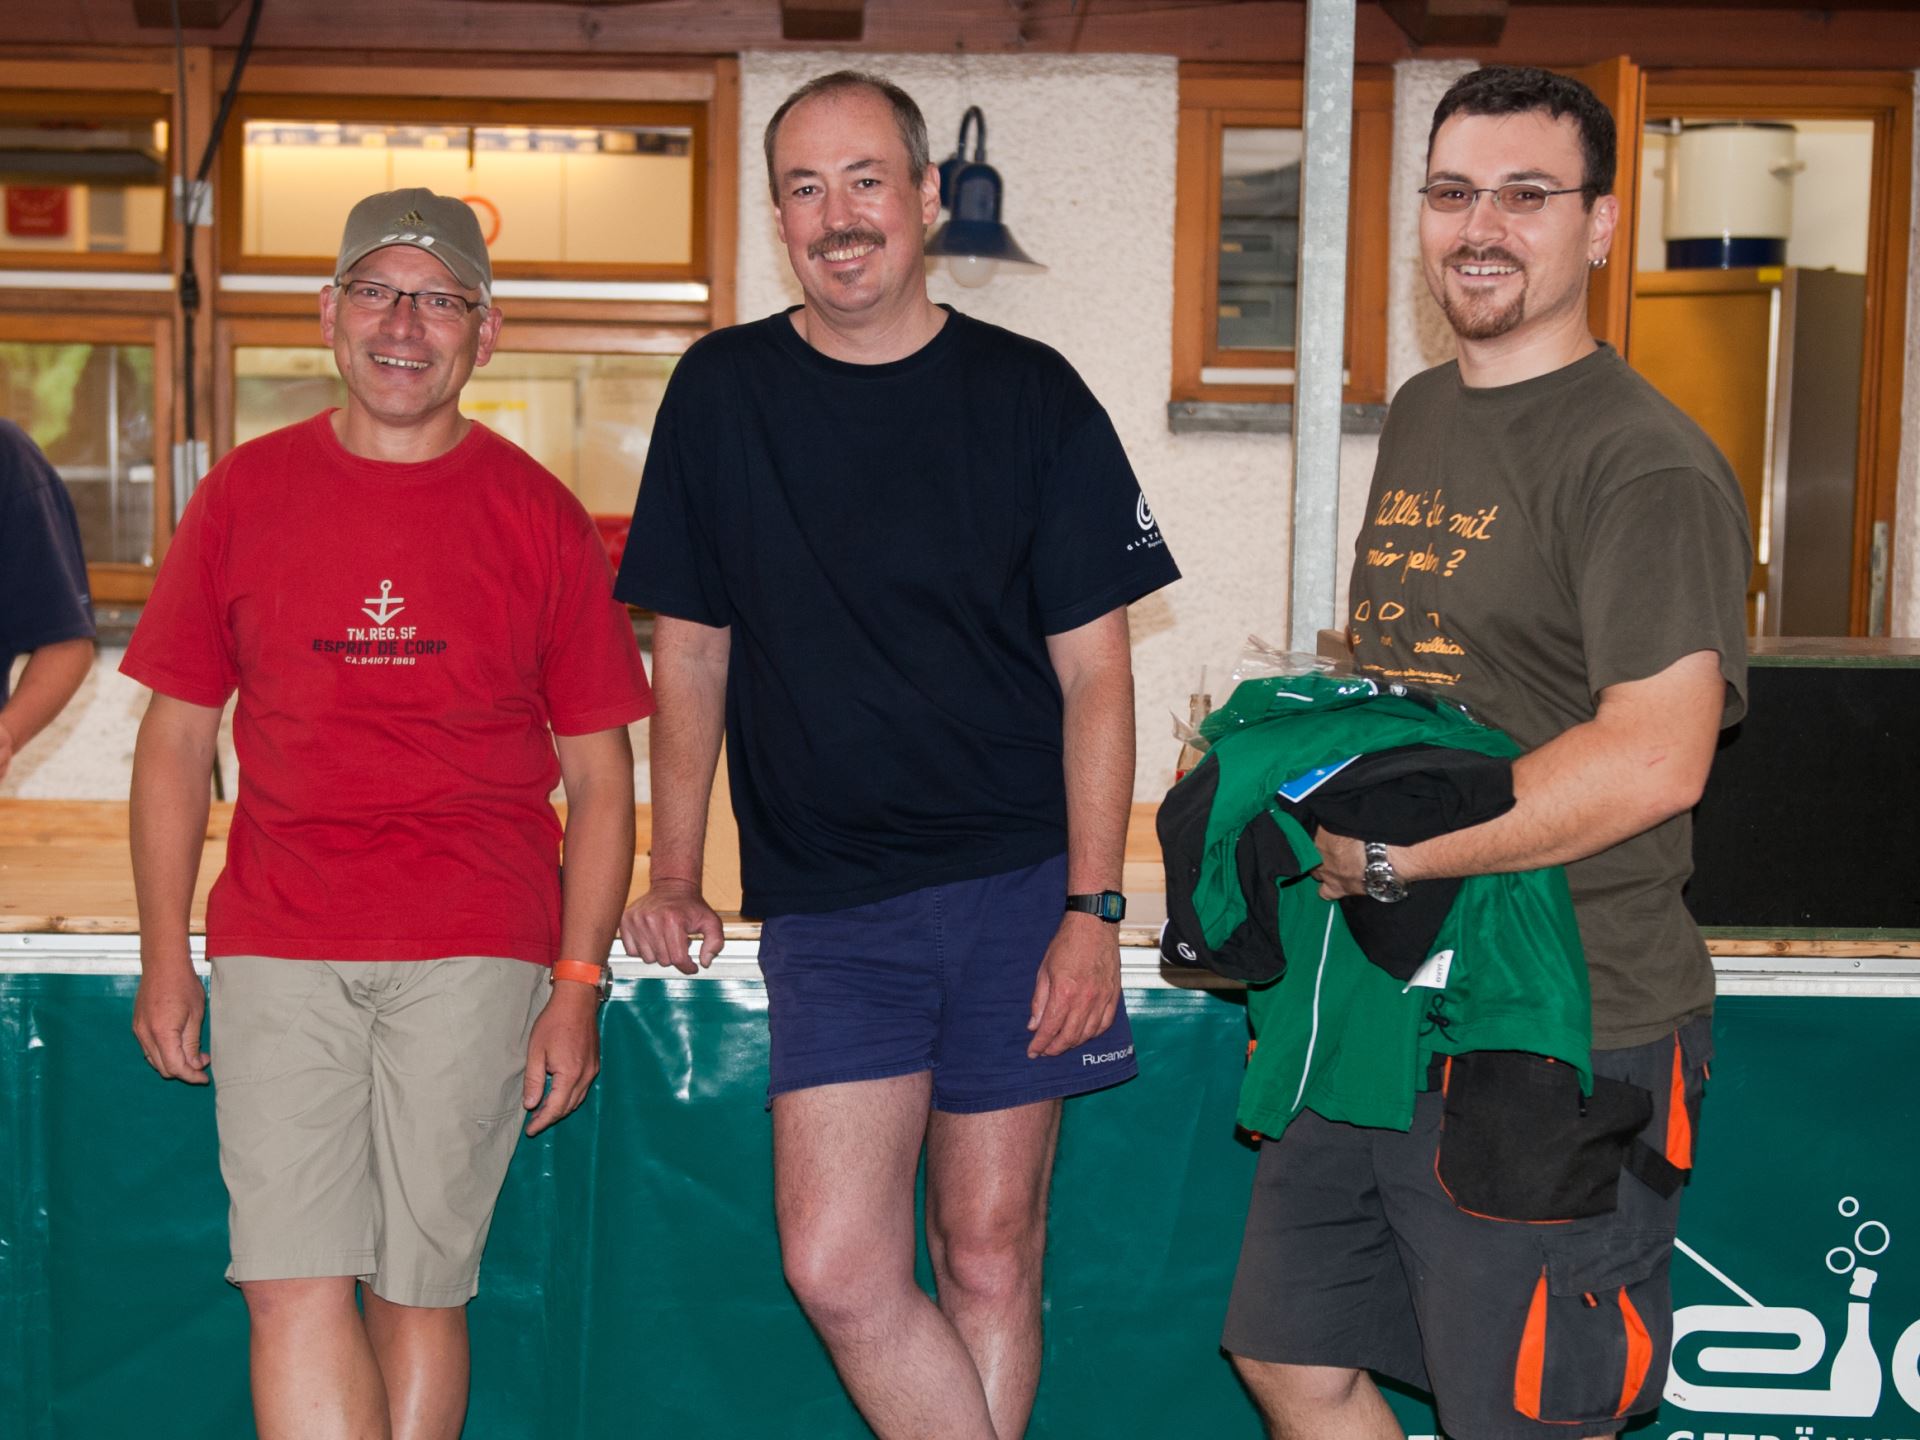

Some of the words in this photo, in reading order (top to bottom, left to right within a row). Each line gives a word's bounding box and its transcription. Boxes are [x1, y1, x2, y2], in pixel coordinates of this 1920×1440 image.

[1448, 504, 1500, 540] mit
[346, 626, 417, 641] TM.REG.SF
[312, 639, 373, 655] ESPRIT
[377, 641, 398, 655] DE
[403, 640, 447, 655] CORP
[1082, 1049, 1127, 1066] Rucanor
